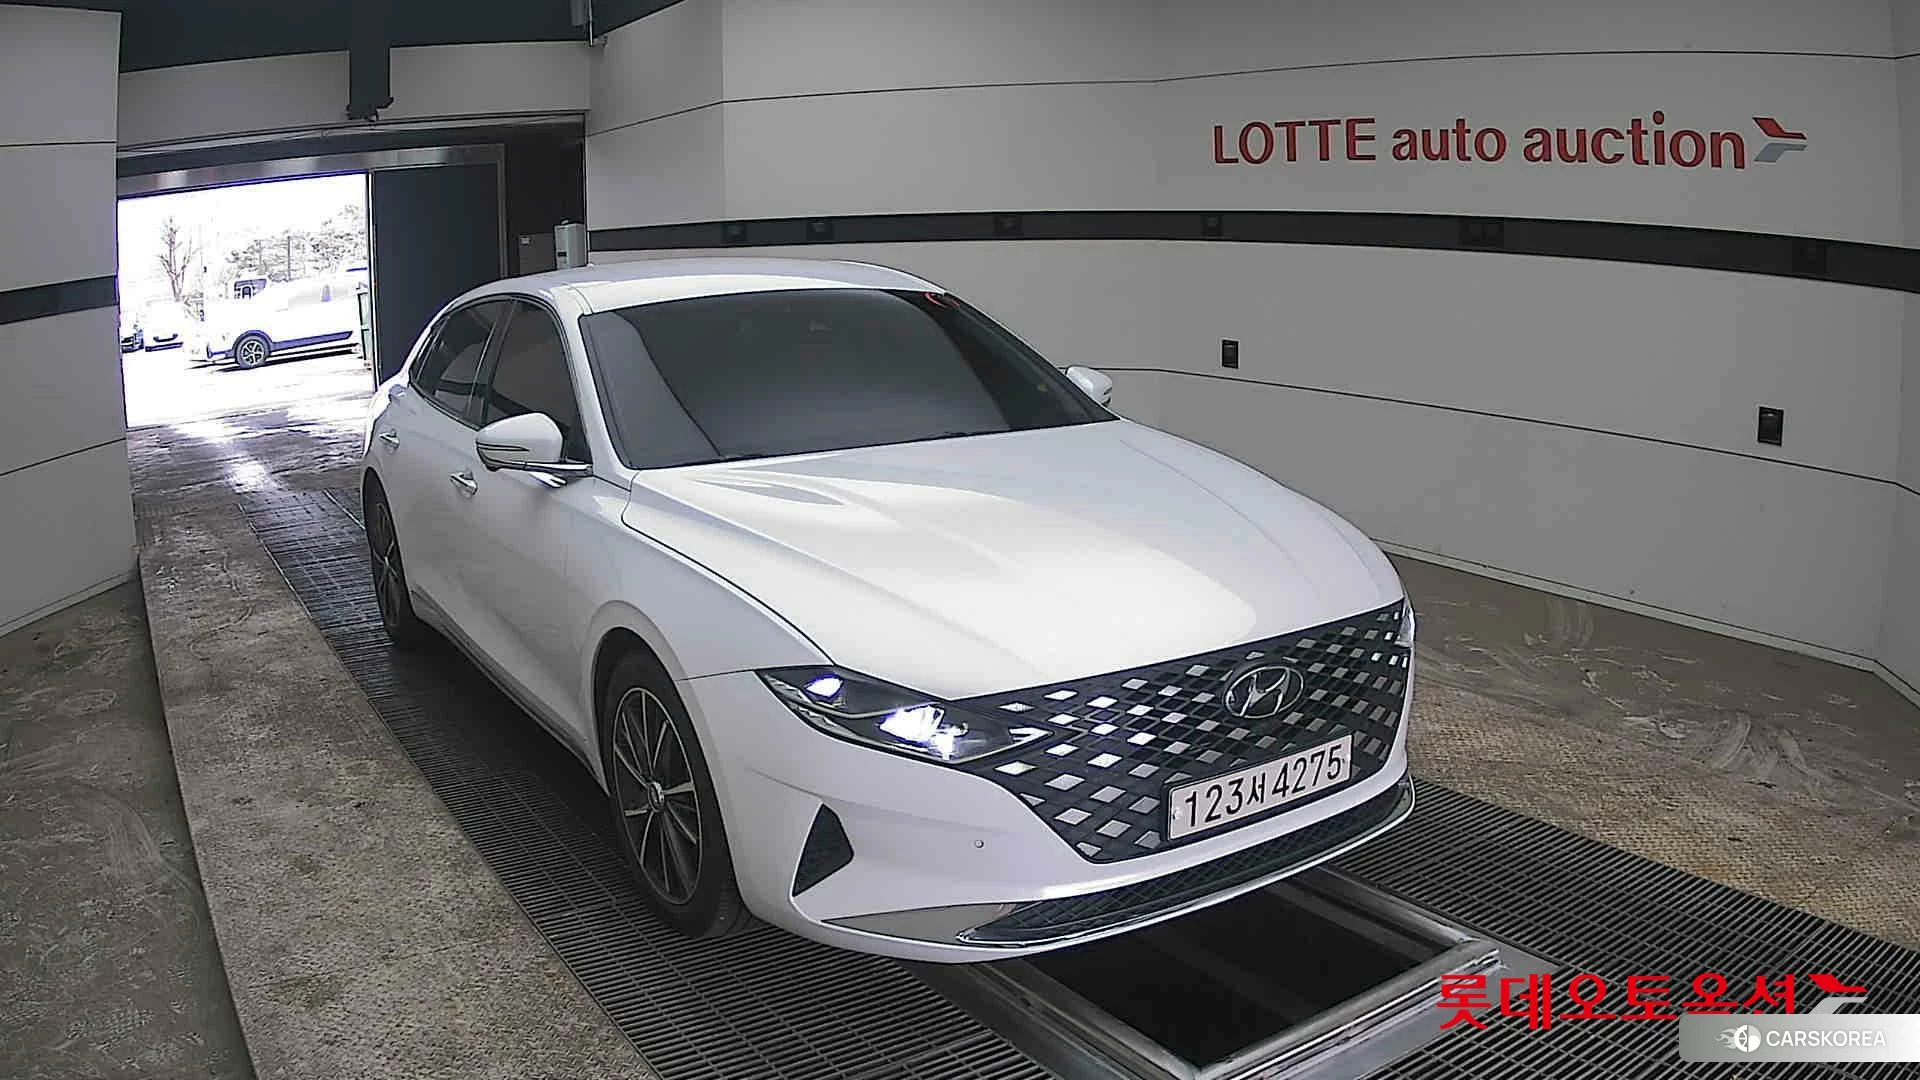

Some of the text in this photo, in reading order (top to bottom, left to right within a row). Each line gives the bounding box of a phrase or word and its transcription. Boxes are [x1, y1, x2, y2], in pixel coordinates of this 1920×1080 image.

[1213, 110, 1746, 169] LOTTE auto auction
